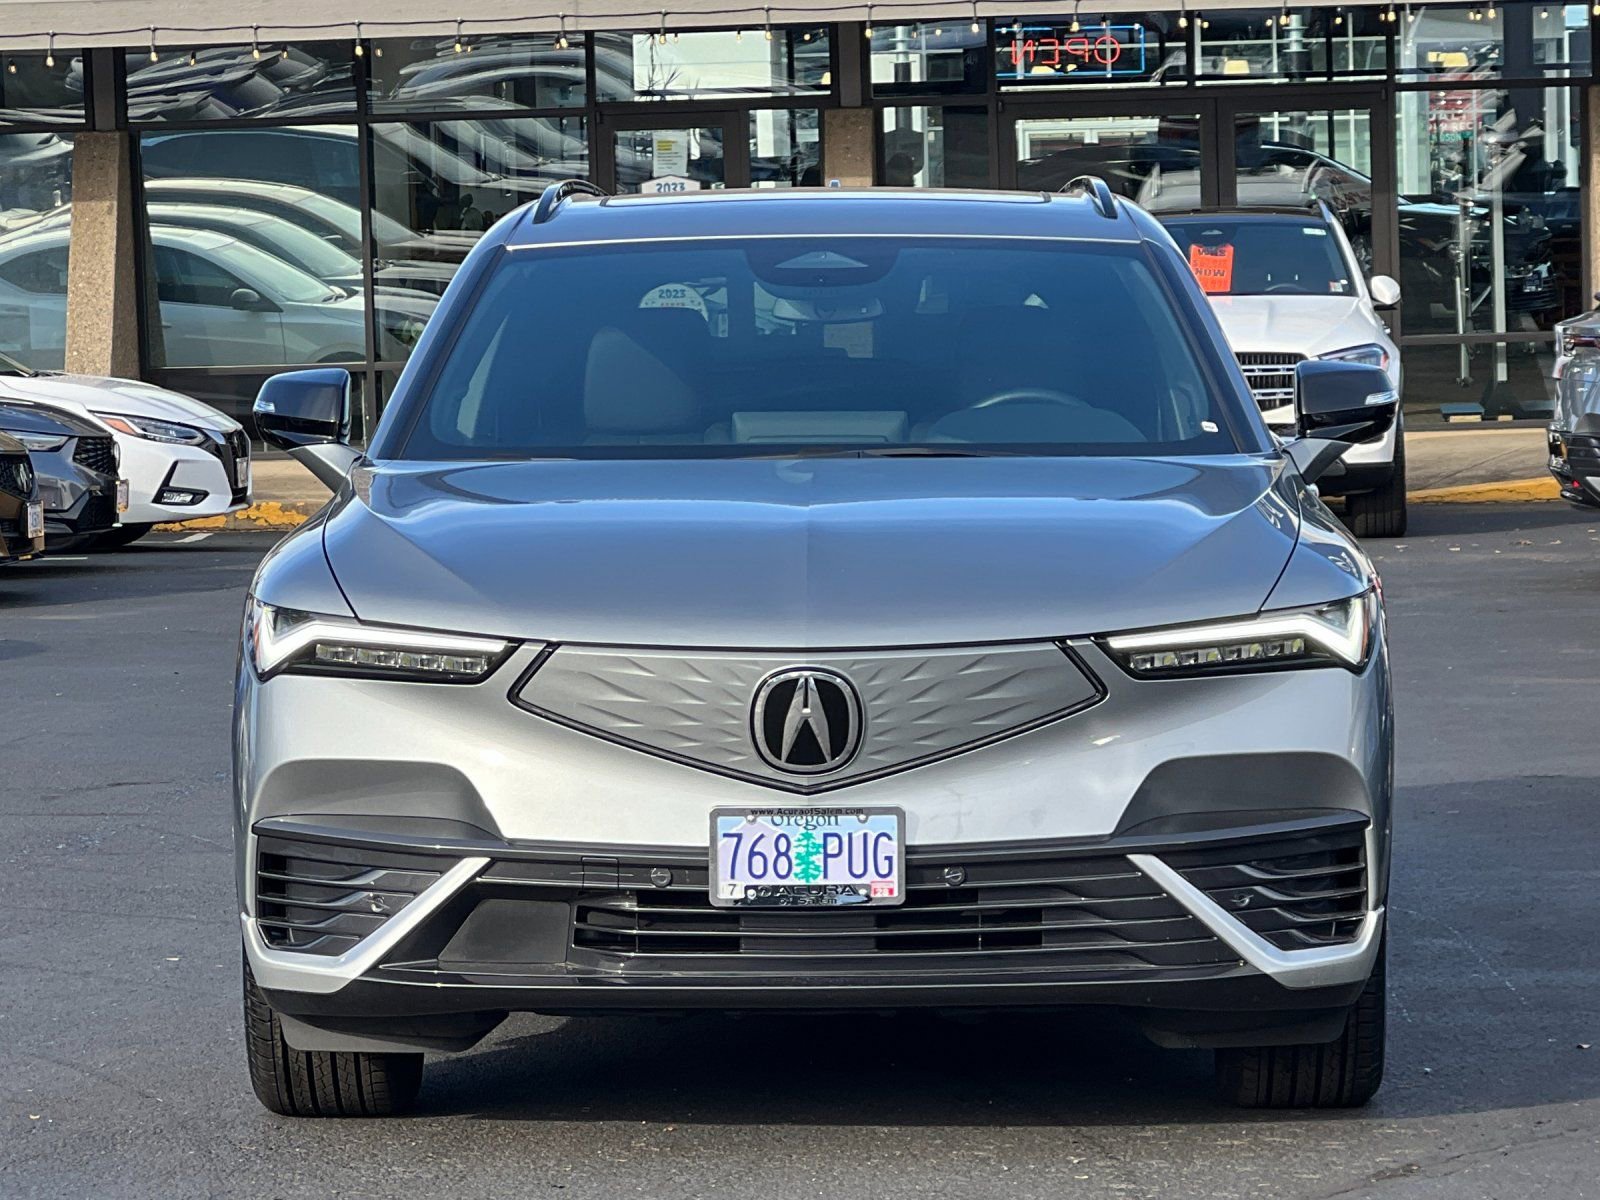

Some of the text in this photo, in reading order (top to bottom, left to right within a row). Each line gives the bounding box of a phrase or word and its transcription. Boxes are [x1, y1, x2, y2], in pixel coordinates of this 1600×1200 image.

[658, 288, 686, 299] 2023
[751, 807, 864, 816] www.AcuraofSalem.com
[770, 815, 841, 831] Oregon
[722, 832, 894, 880] 768 PUG
[728, 884, 737, 896] 7
[775, 884, 858, 896] ACURA
